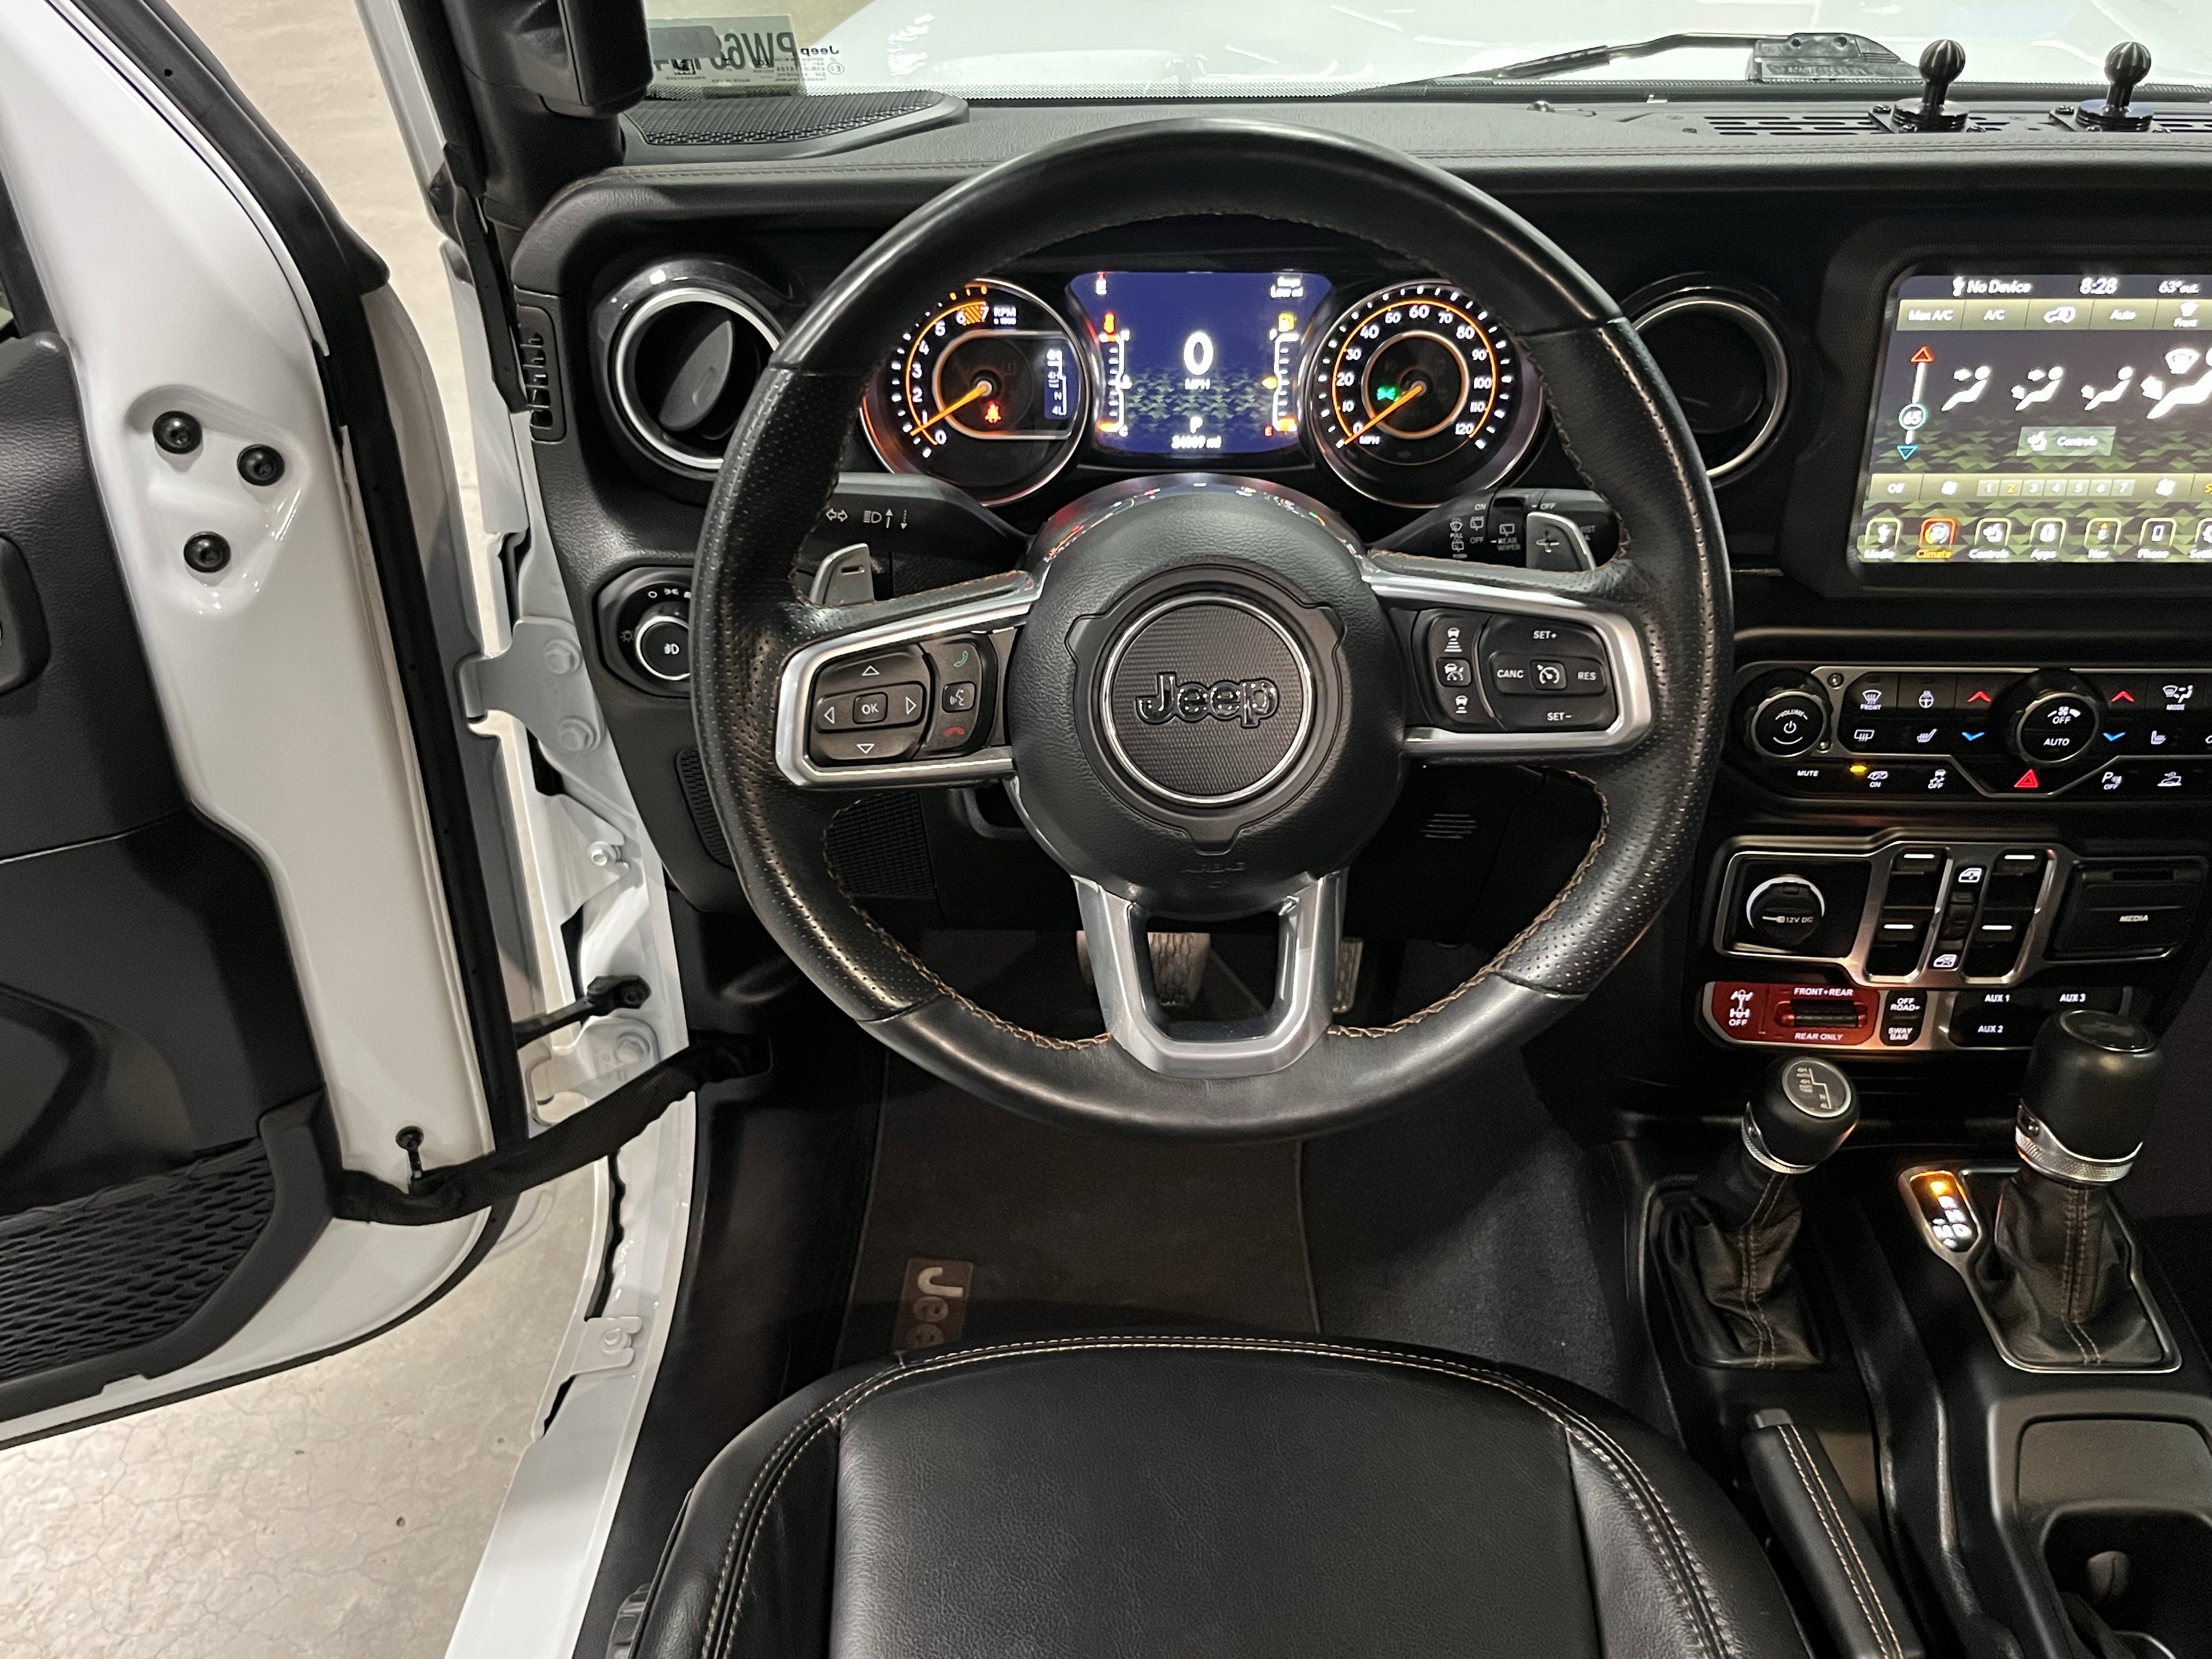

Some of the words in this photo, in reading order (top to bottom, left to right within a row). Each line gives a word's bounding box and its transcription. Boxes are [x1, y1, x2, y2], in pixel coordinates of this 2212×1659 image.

[1967, 280, 1988, 294] No
[1988, 279, 2032, 294] Device
[2080, 277, 2118, 295] 8:28
[956, 312, 966, 323] 6
[994, 306, 1016, 317] RPM
[1409, 306, 1430, 319] 60
[1983, 309, 2005, 320] A/C
[1385, 312, 1401, 324] 50
[1438, 312, 1453, 324] 70
[935, 323, 946, 336] 5
[1361, 326, 1380, 338] 40
[1457, 326, 1475, 339] 80
[919, 340, 930, 355] 4
[1183, 331, 1214, 376] 0
[1346, 348, 1361, 360] 30
[1472, 349, 1487, 360] 90
[912, 364, 922, 378] 3
[1185, 378, 1210, 390] MPH
[1336, 373, 1354, 386] 20
[1473, 376, 1492, 390] 100
[912, 388, 923, 402] 2
[1342, 401, 1354, 412] 10
[1470, 401, 1486, 412] 110
[922, 410, 928, 425] 1
[1455, 422, 1474, 435] 120
[935, 431, 947, 444] 0
[1359, 436, 1380, 445] MPH
[1986, 483, 1992, 493] 1
[2007, 483, 2017, 494] 2
[2029, 483, 2039, 493] 3
[2052, 483, 2061, 493] 4
[2074, 483, 2083, 493] 5
[2096, 483, 2106, 493] 6
[2119, 482, 2128, 493] 7
[1916, 549, 1953, 559] Climate
[2030, 549, 2056, 561] Apps
[1497, 669, 1524, 679] CANC
[1577, 672, 1596, 680] RES
[1136, 672, 1279, 729] Jeep
[861, 702, 879, 714] OK
[1984, 994, 2003, 1002] AUX
[2059, 994, 2079, 1002] AUX
[2079, 994, 2086, 1002] 3
[1978, 1025, 1997, 1033] AUX
[1997, 1025, 2004, 1033] 2
[911, 1266, 963, 1348] Jee
